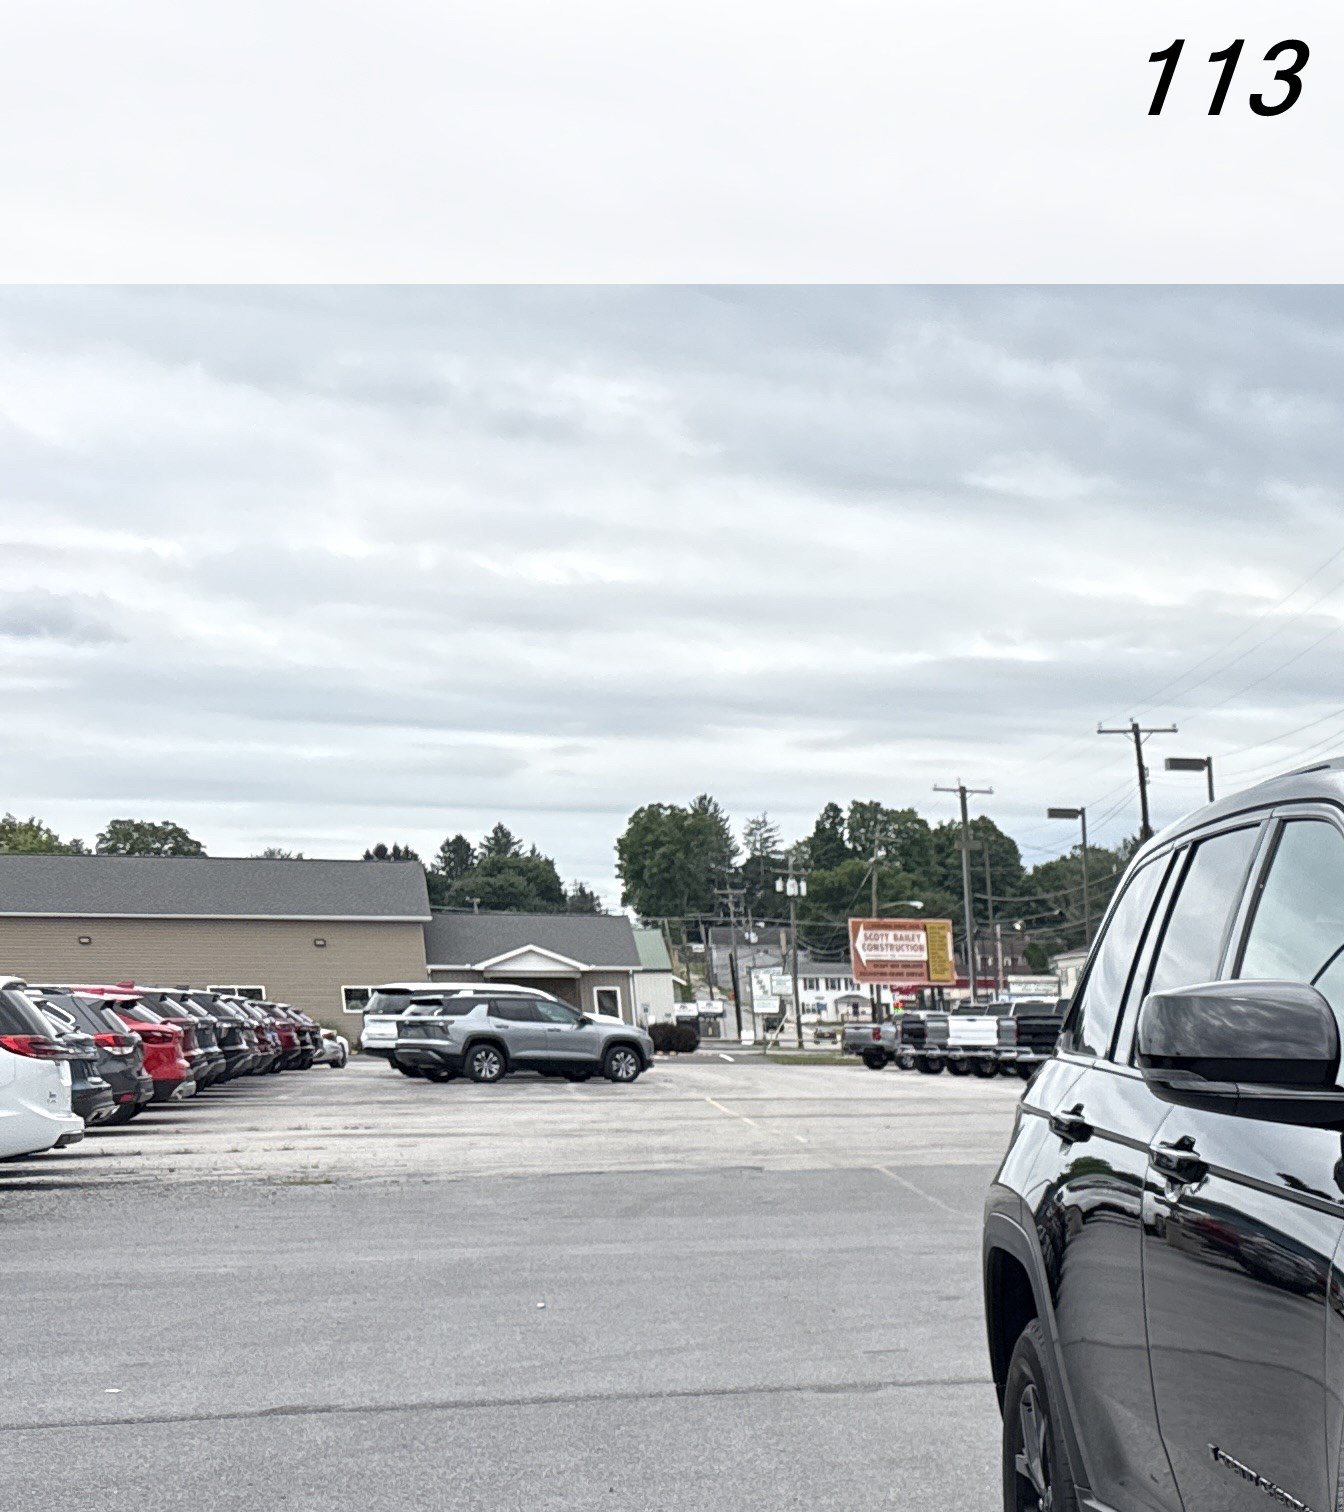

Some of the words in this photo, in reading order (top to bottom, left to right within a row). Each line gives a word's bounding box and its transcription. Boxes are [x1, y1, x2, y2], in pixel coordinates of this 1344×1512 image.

[863, 932, 889, 942] SCOTT
[893, 933, 921, 942] BAILEY
[861, 943, 925, 953] CONSTRUCTION
